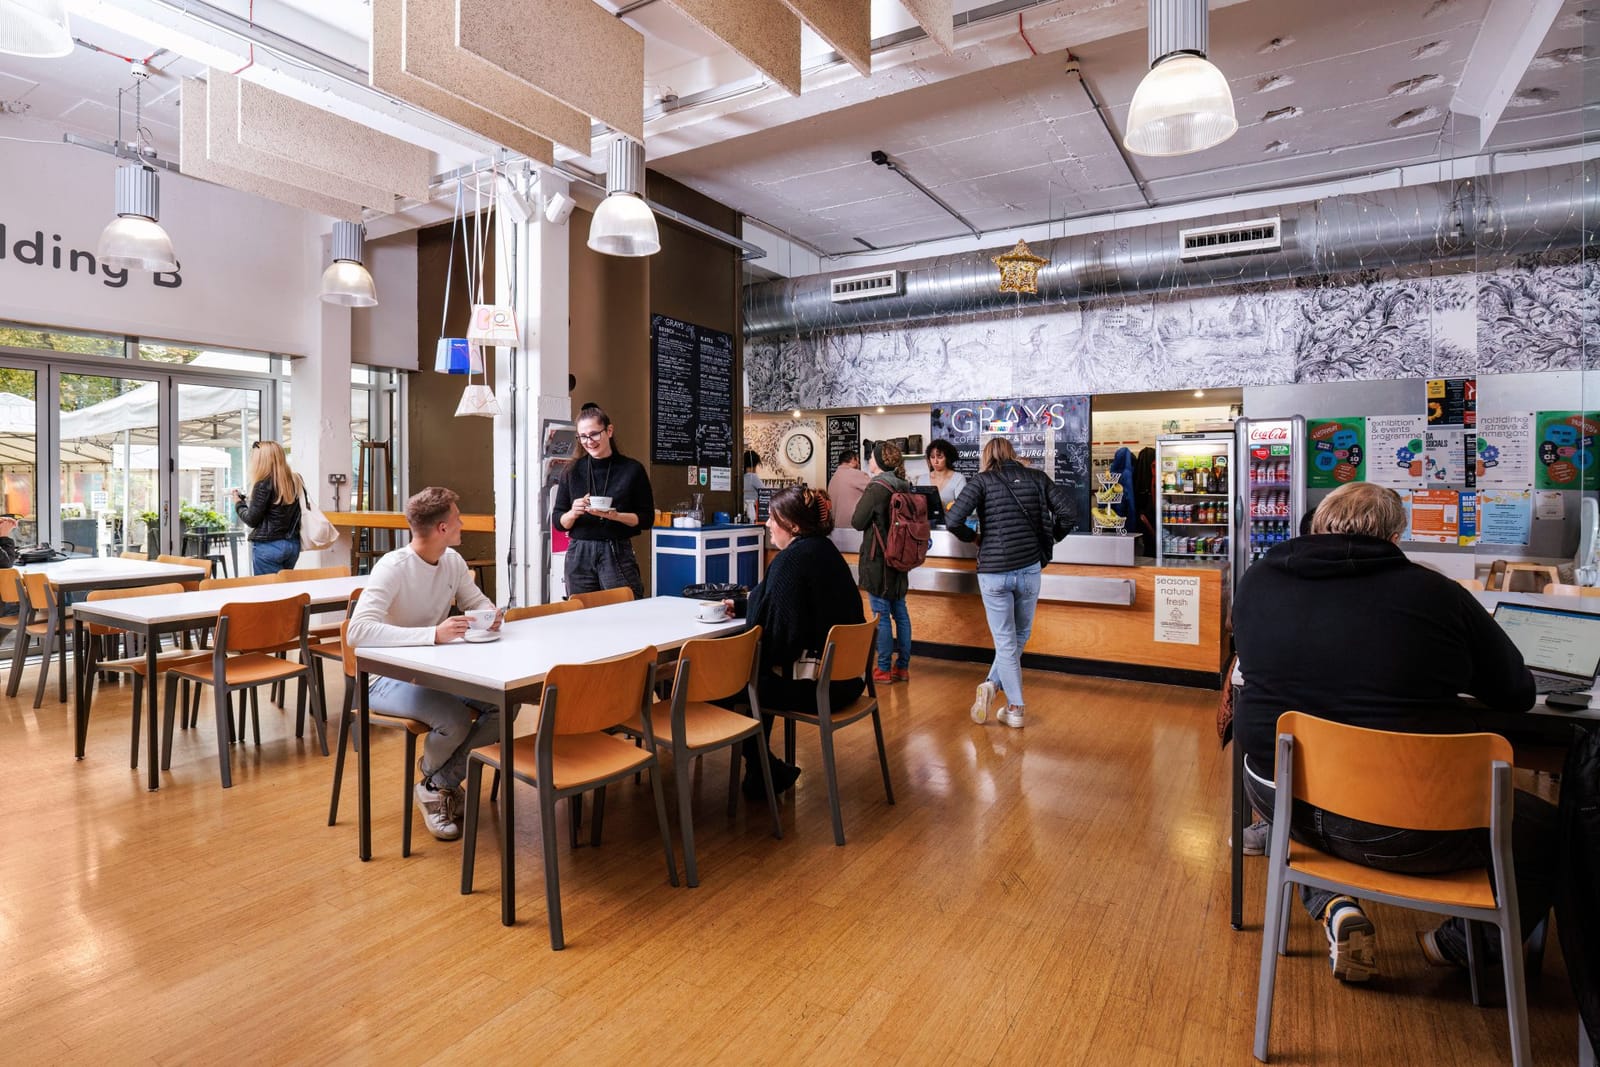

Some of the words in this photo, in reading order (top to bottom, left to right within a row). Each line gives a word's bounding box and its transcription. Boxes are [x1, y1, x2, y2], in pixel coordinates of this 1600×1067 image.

[951, 403, 1065, 433] GRAYS
[1371, 419, 1415, 427] exhibition
[953, 436, 980, 444] COFFE
[1371, 432, 1422, 441] programme
[1252, 503, 1290, 514] GRAYS
[1156, 577, 1198, 586] seasonal
[1160, 587, 1194, 597] natural
